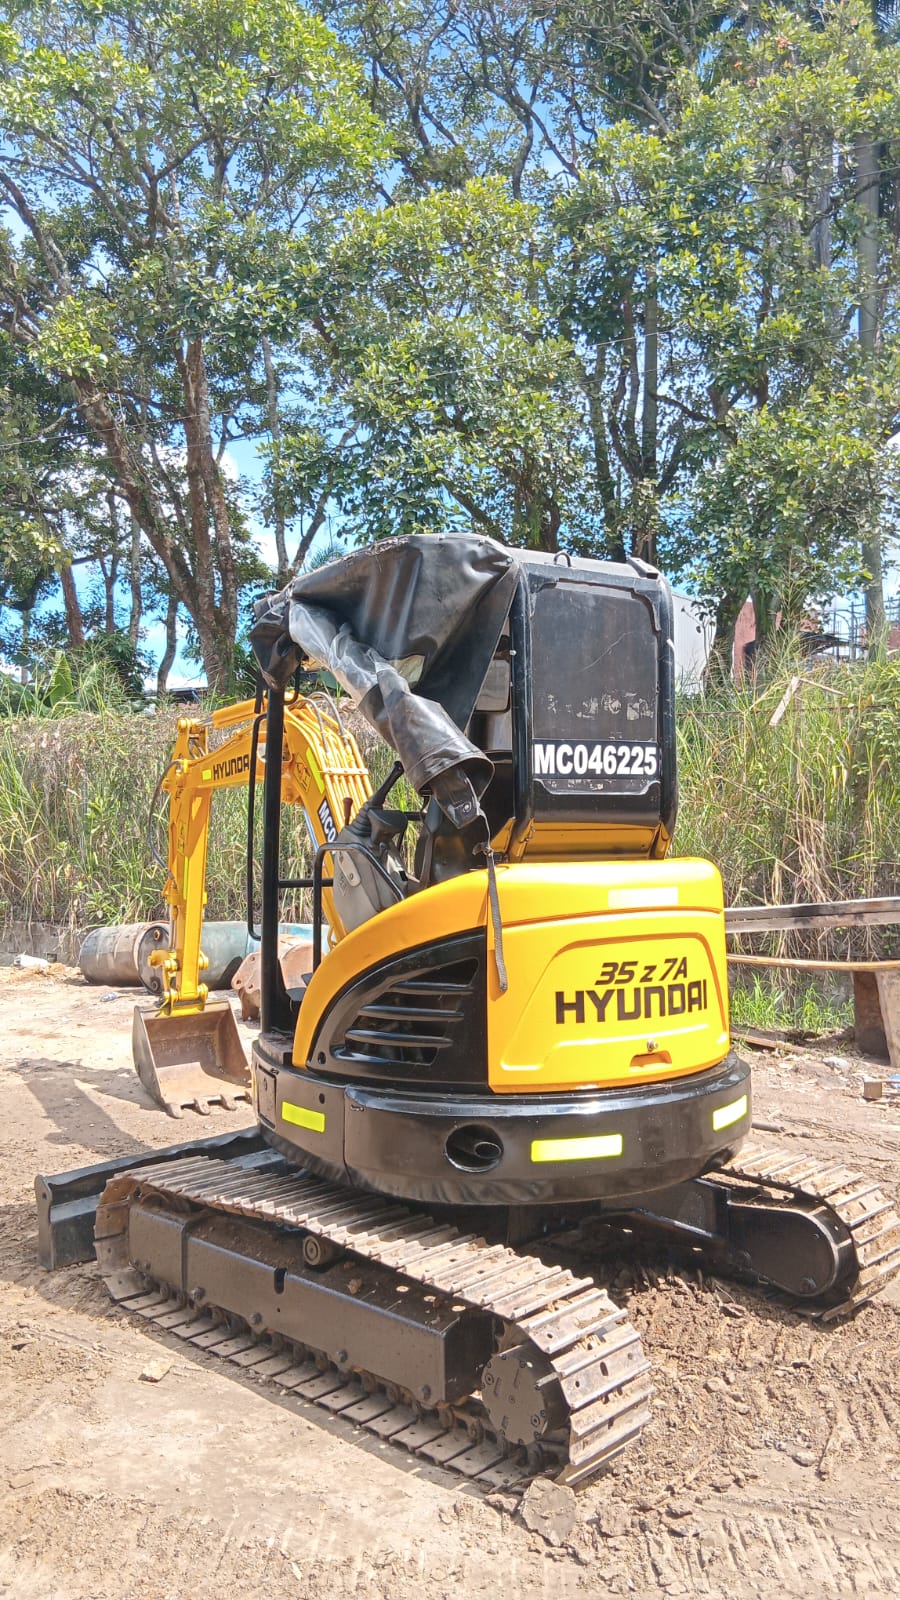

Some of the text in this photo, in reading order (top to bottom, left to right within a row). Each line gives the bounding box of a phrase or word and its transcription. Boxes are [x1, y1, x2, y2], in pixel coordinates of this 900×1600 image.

[213, 754, 250, 781] HYUNDA
[534, 744, 657, 775] MC046225
[595, 961, 638, 985] 35
[659, 956, 688, 980] 7A
[555, 979, 707, 1025] HYUNDAI
